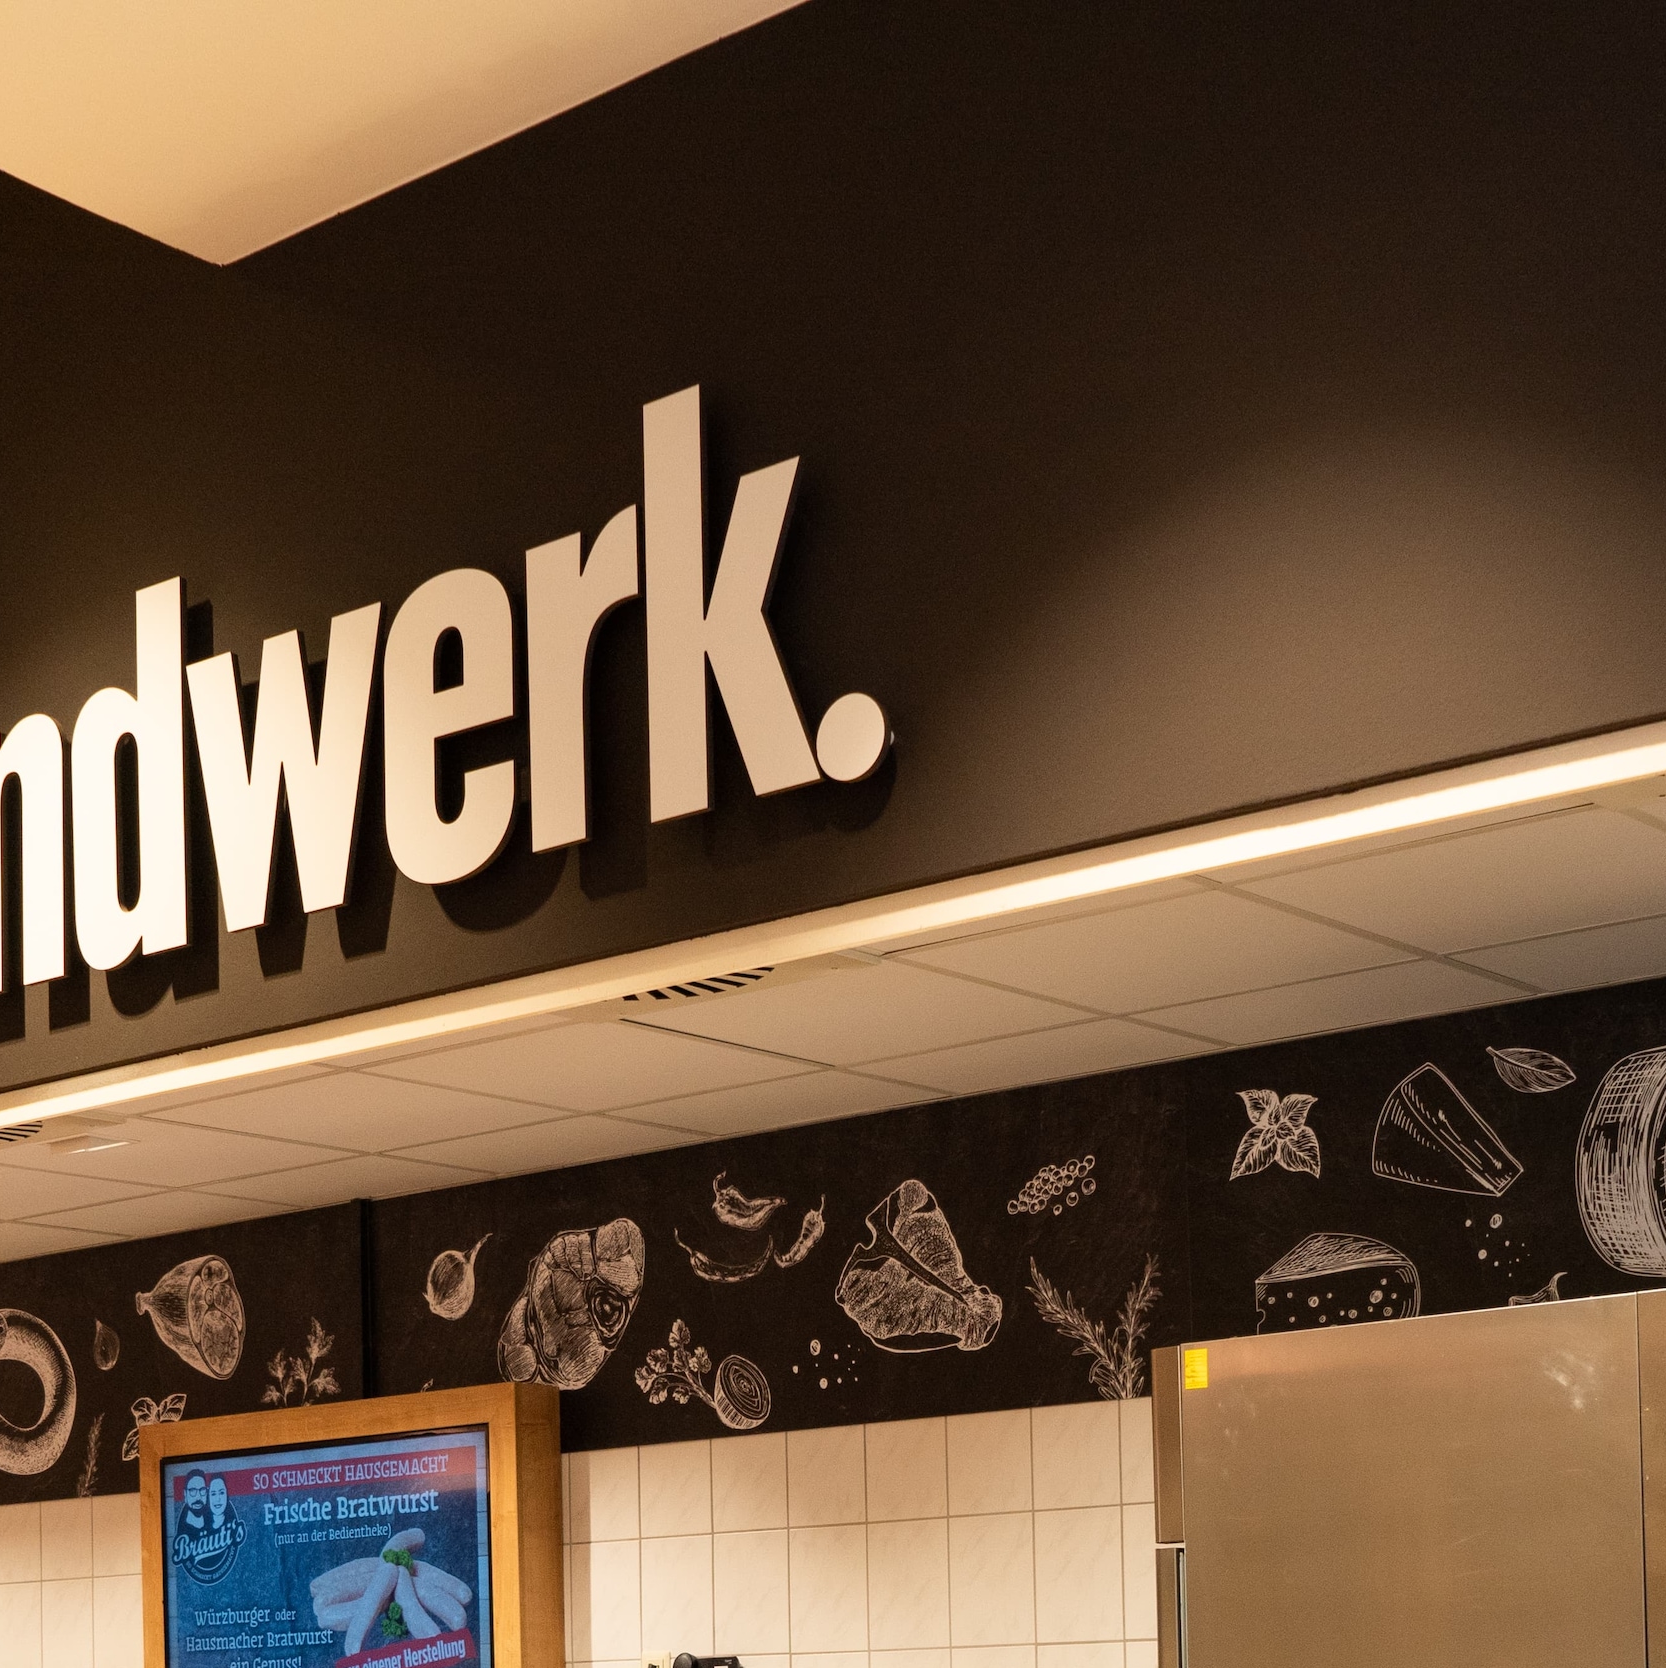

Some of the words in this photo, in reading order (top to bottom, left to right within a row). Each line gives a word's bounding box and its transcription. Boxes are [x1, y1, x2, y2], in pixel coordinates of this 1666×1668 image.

[253, 1474, 269, 1490] SO
[272, 1466, 342, 1489] SCHMECKT
[345, 1455, 449, 1482] HAUSGEMACHT
[263, 1497, 332, 1526] Frische
[337, 1488, 439, 1520] Bratwurst
[274, 1531, 295, 1547] (nur
[297, 1533, 310, 1544] an
[311, 1529, 327, 1543] der
[329, 1523, 392, 1541] Bedientheke)
[194, 1607, 270, 1627] Würzburger
[275, 1608, 296, 1622] oder
[186, 1634, 264, 1653] Hausmacher
[266, 1629, 334, 1649] Bratwurst
